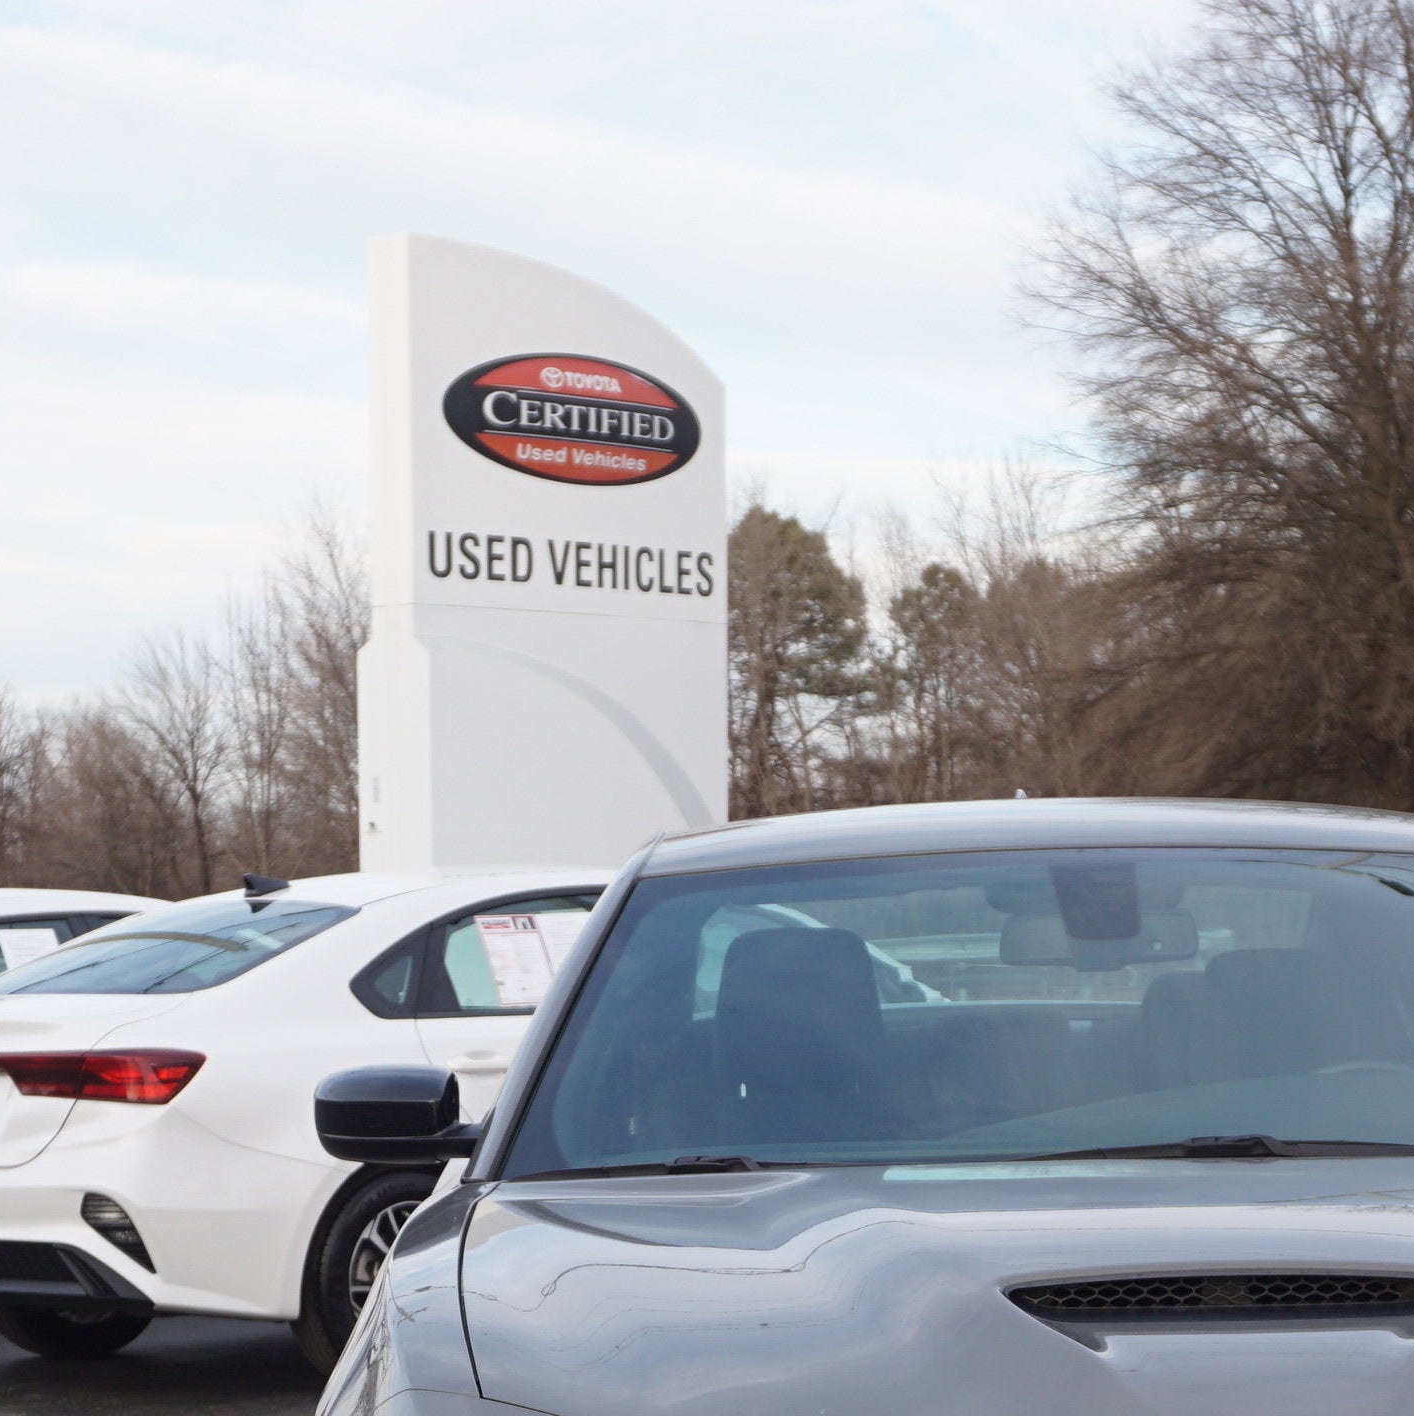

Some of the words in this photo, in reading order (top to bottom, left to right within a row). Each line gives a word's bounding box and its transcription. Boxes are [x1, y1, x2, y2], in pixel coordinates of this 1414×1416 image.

[564, 371, 622, 394] TOYOTA
[483, 391, 675, 441] CERTIFIED
[516, 443, 567, 464] Used
[571, 447, 647, 472] Vehicles
[428, 530, 534, 583] USED
[548, 538, 714, 597] VEHICLES
